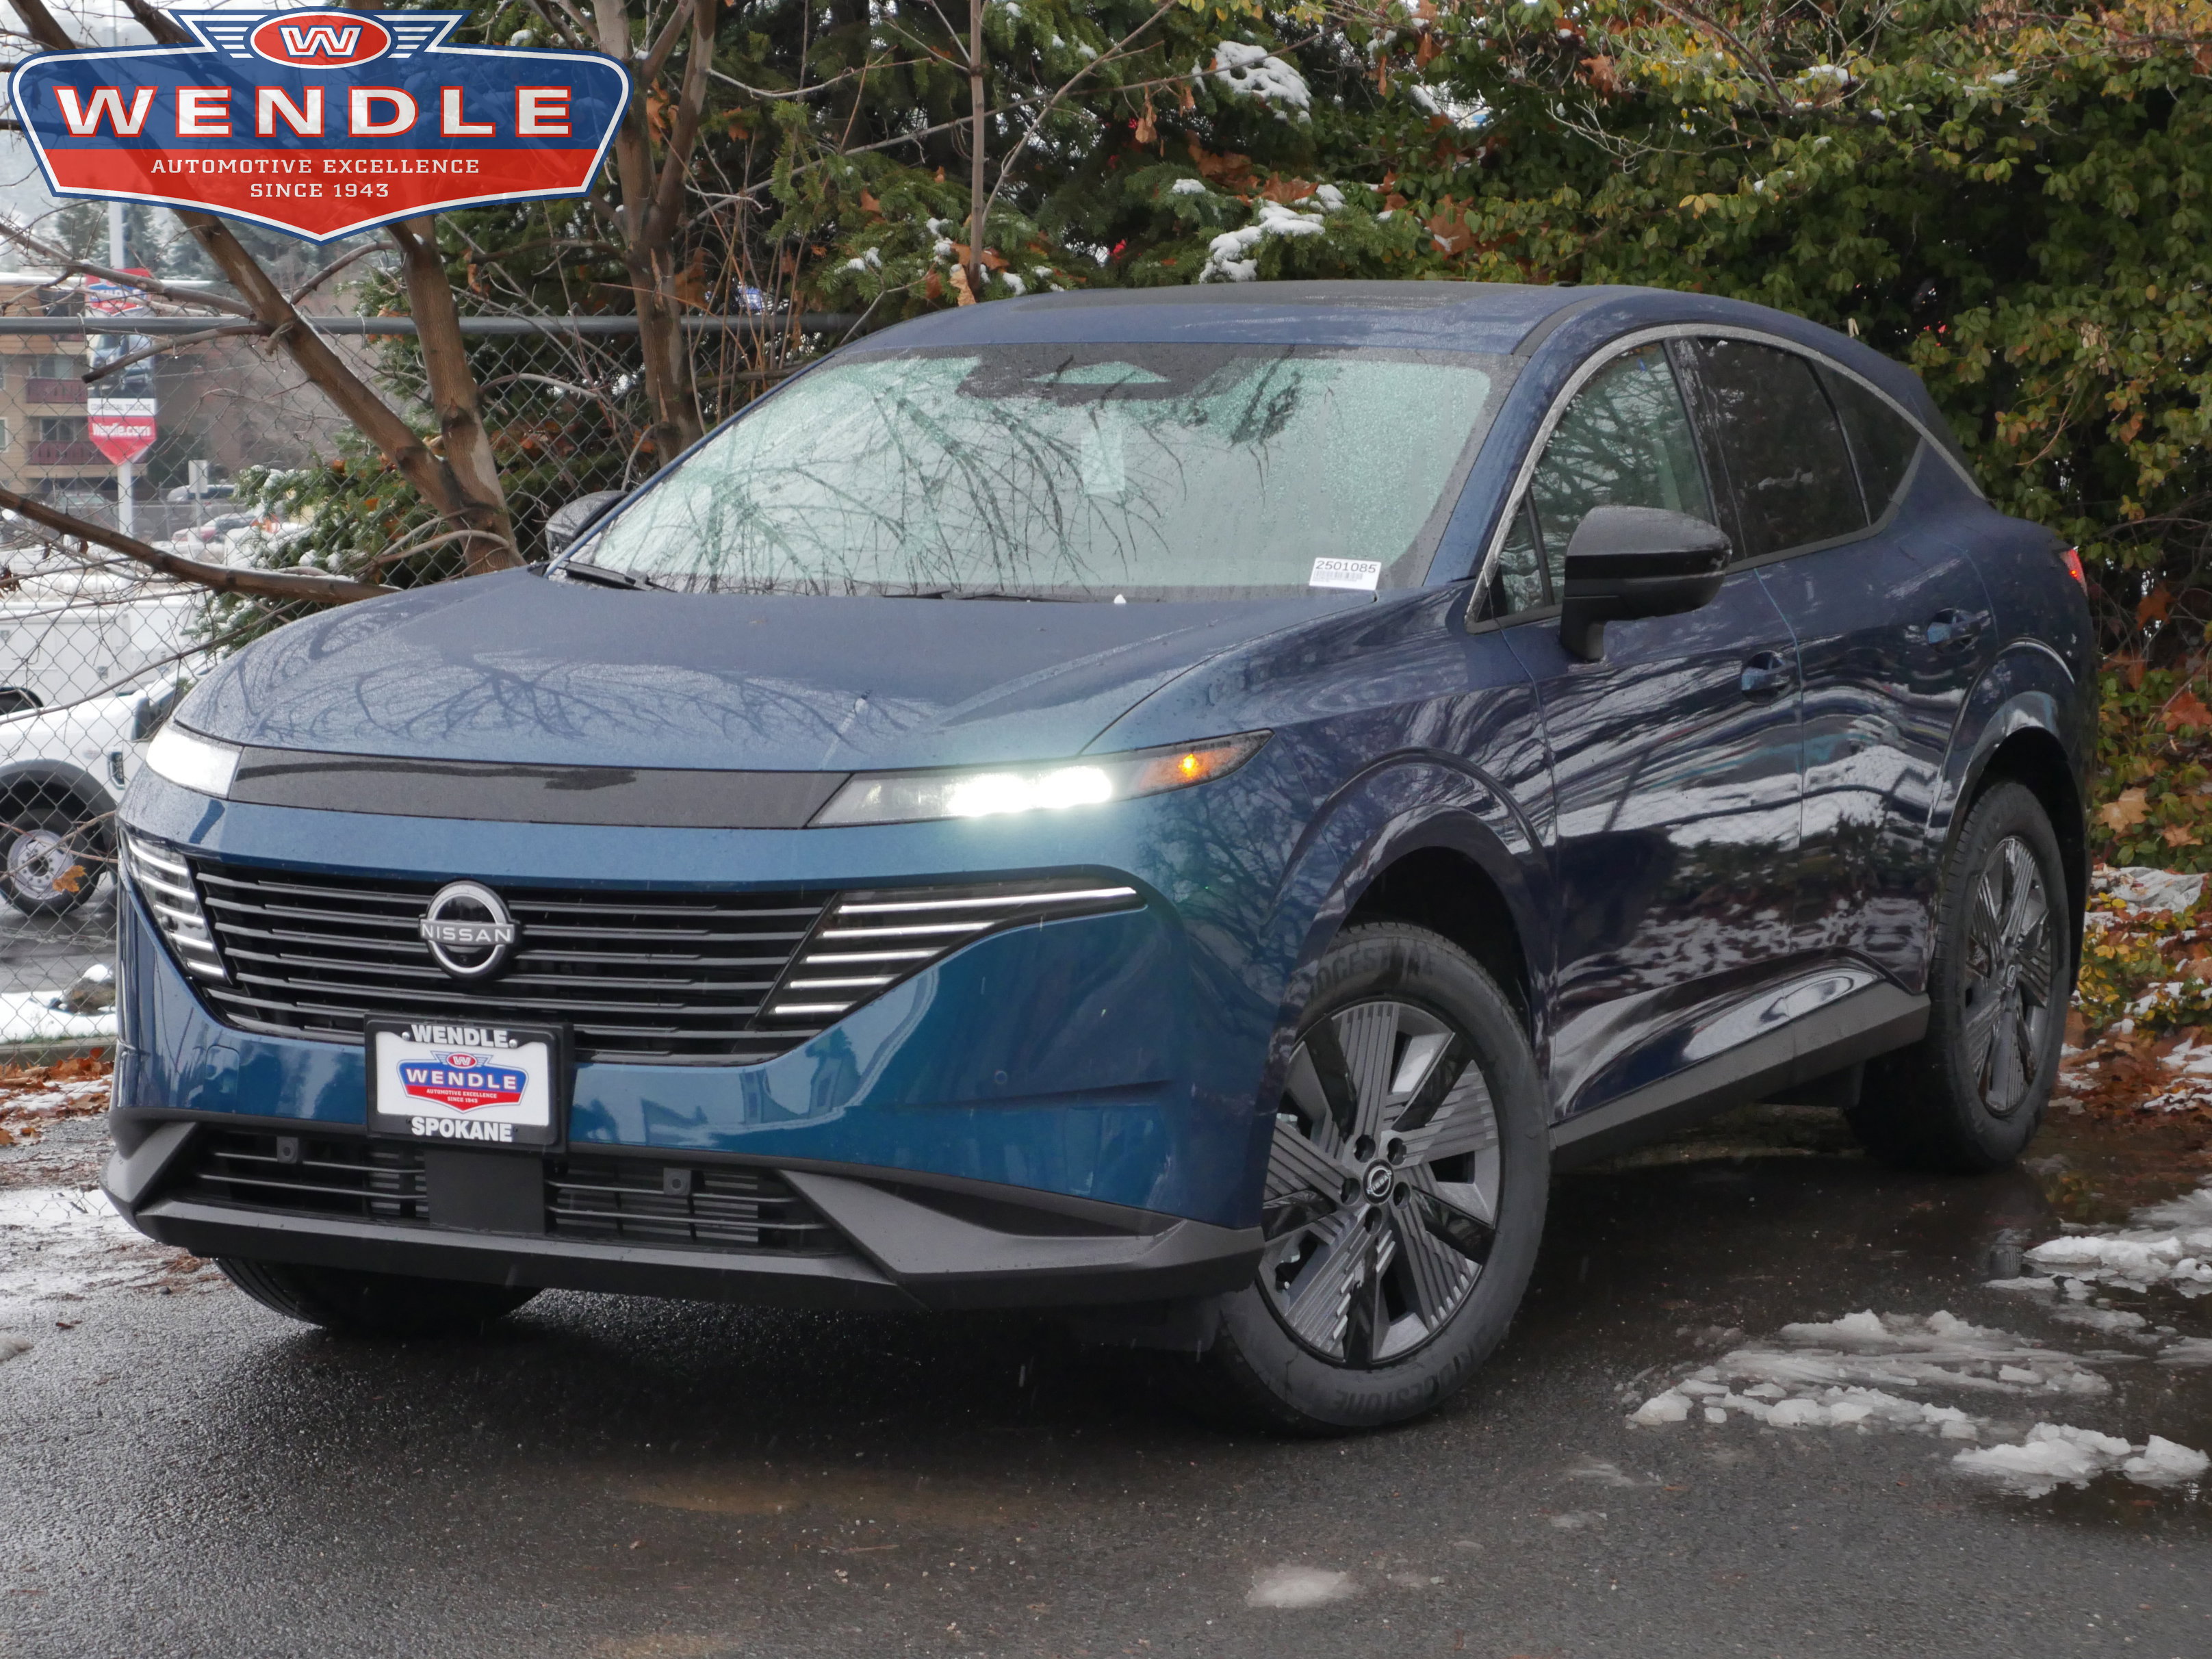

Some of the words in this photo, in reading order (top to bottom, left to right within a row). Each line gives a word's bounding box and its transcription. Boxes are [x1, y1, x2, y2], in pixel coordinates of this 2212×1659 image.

[1315, 560, 1377, 573] 2501085
[422, 922, 512, 943] NISSAN
[411, 1024, 509, 1049] WENDLE
[405, 1068, 517, 1090] WENDLE
[426, 1088, 461, 1096] AUTOMOTIVE
[411, 1116, 513, 1143] SPOKANE
